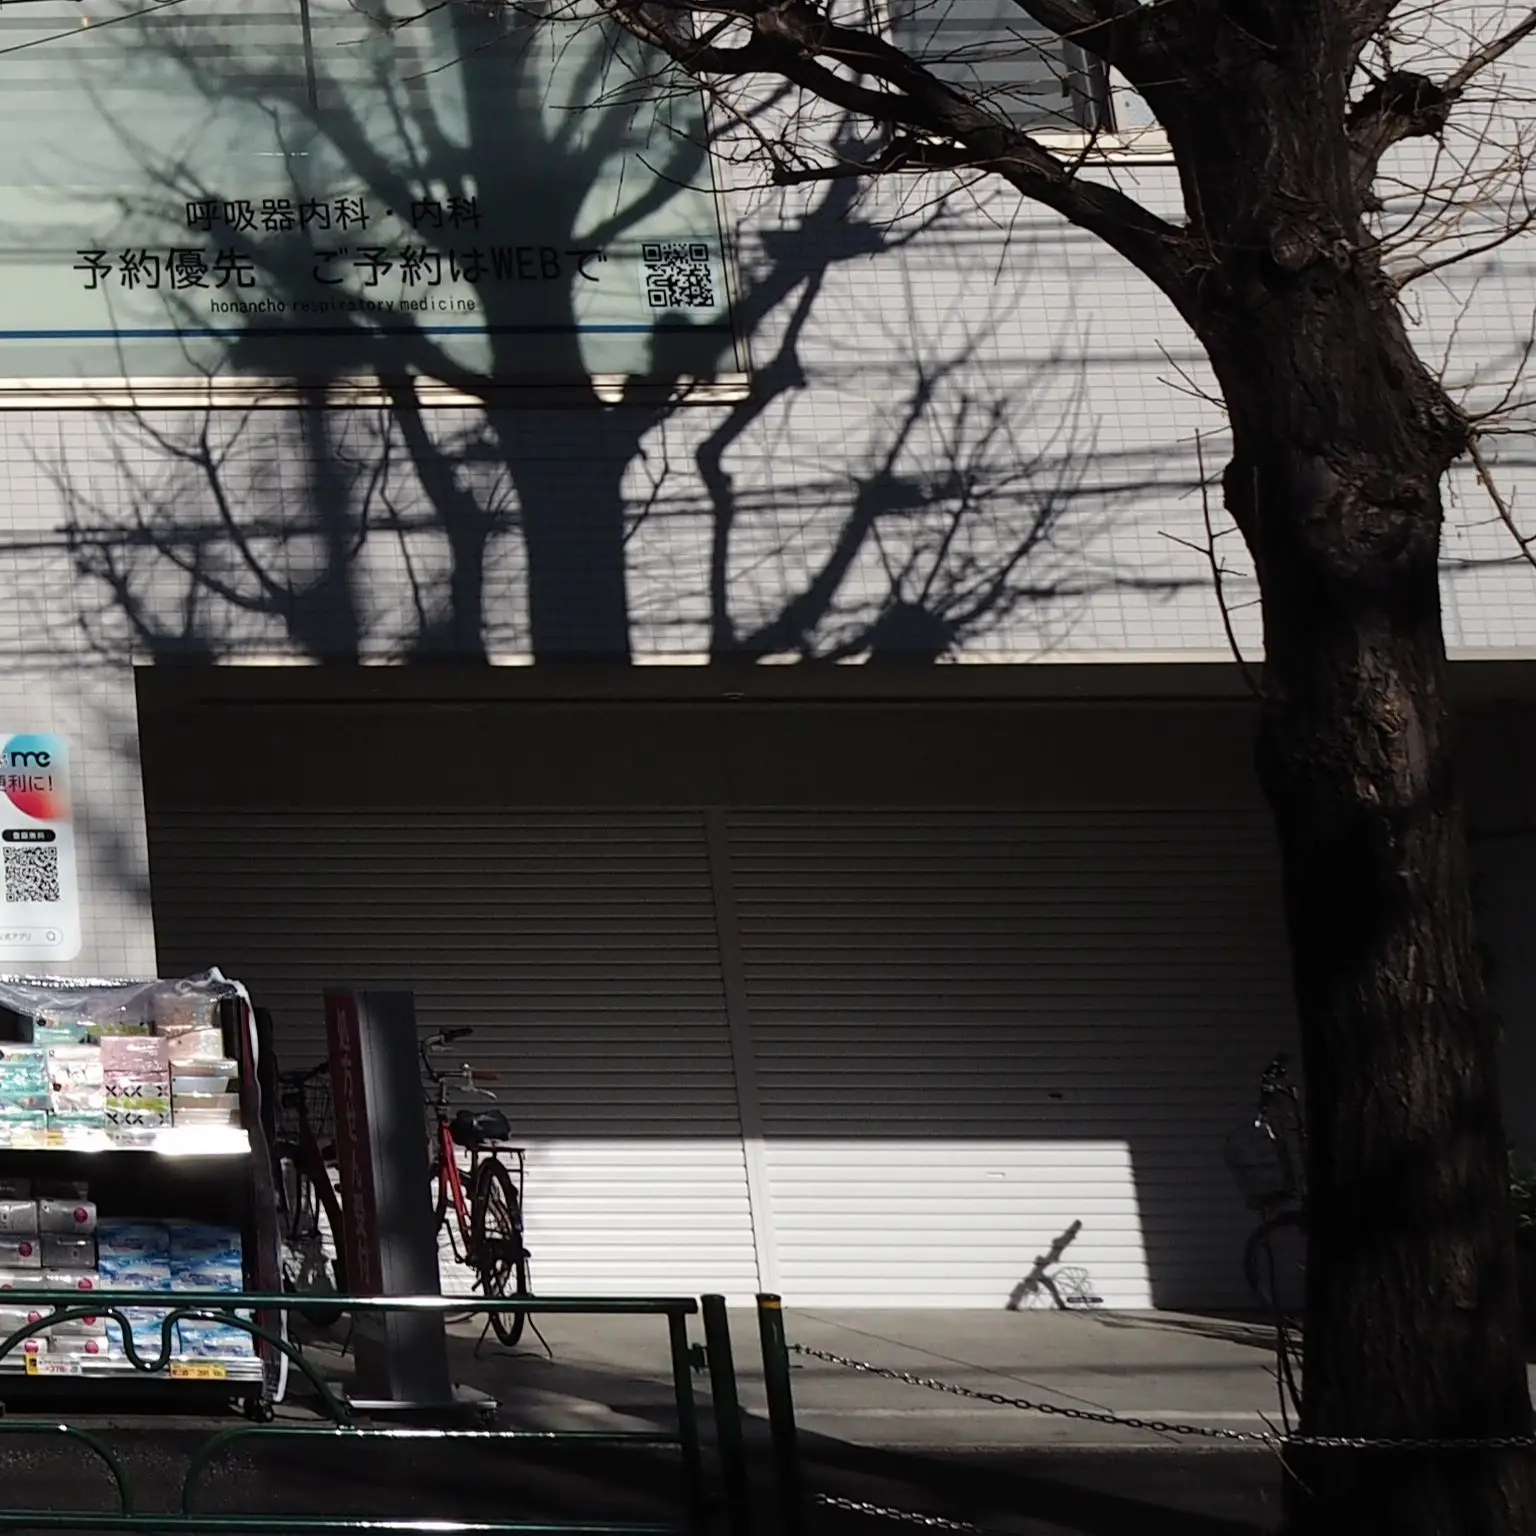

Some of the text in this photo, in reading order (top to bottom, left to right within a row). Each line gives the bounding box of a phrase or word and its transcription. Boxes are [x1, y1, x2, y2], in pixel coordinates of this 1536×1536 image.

[186, 196, 483, 232] 呼吸器内科・内科
[73, 244, 608, 291] 予約優先 ご予約はWEBで
[210, 295, 476, 315] honancho respiratory medicine
